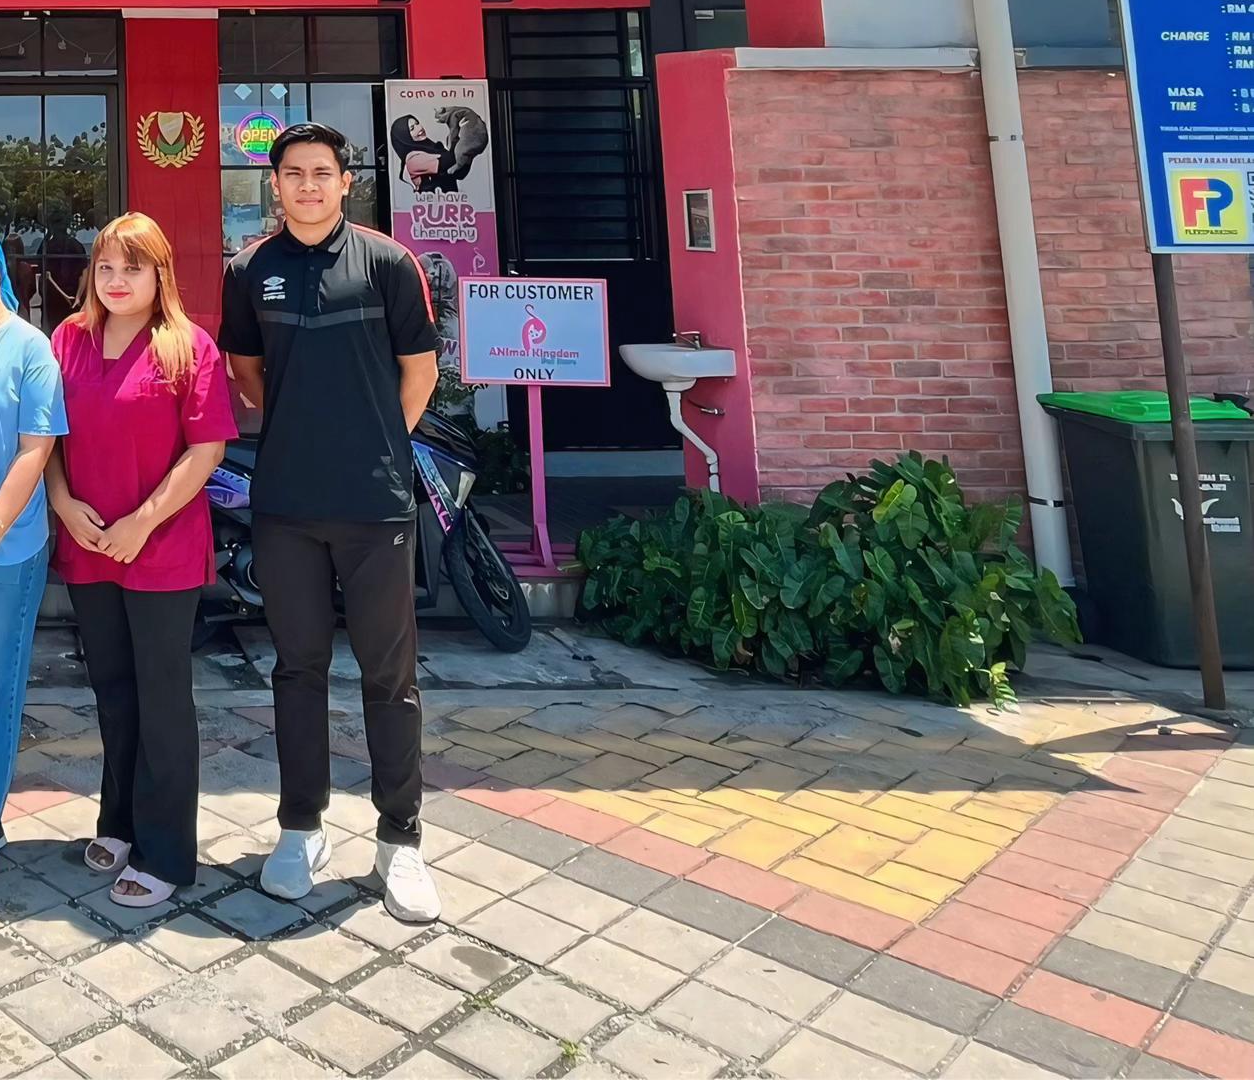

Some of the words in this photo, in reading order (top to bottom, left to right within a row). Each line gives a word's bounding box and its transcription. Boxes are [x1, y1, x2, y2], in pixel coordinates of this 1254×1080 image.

[1161, 31, 1209, 41] CHARGE
[1167, 87, 1204, 97] MASA
[1170, 101, 1197, 111] TIME
[241, 129, 279, 142] OPEN
[415, 193, 433, 203] we
[437, 188, 468, 203] have
[412, 203, 474, 223] PURR
[413, 225, 476, 241] theraphy
[469, 284, 499, 299] FOR
[505, 285, 594, 301] CUSTOMER
[532, 348, 579, 359] Kingdom
[514, 368, 554, 380] ONLY
